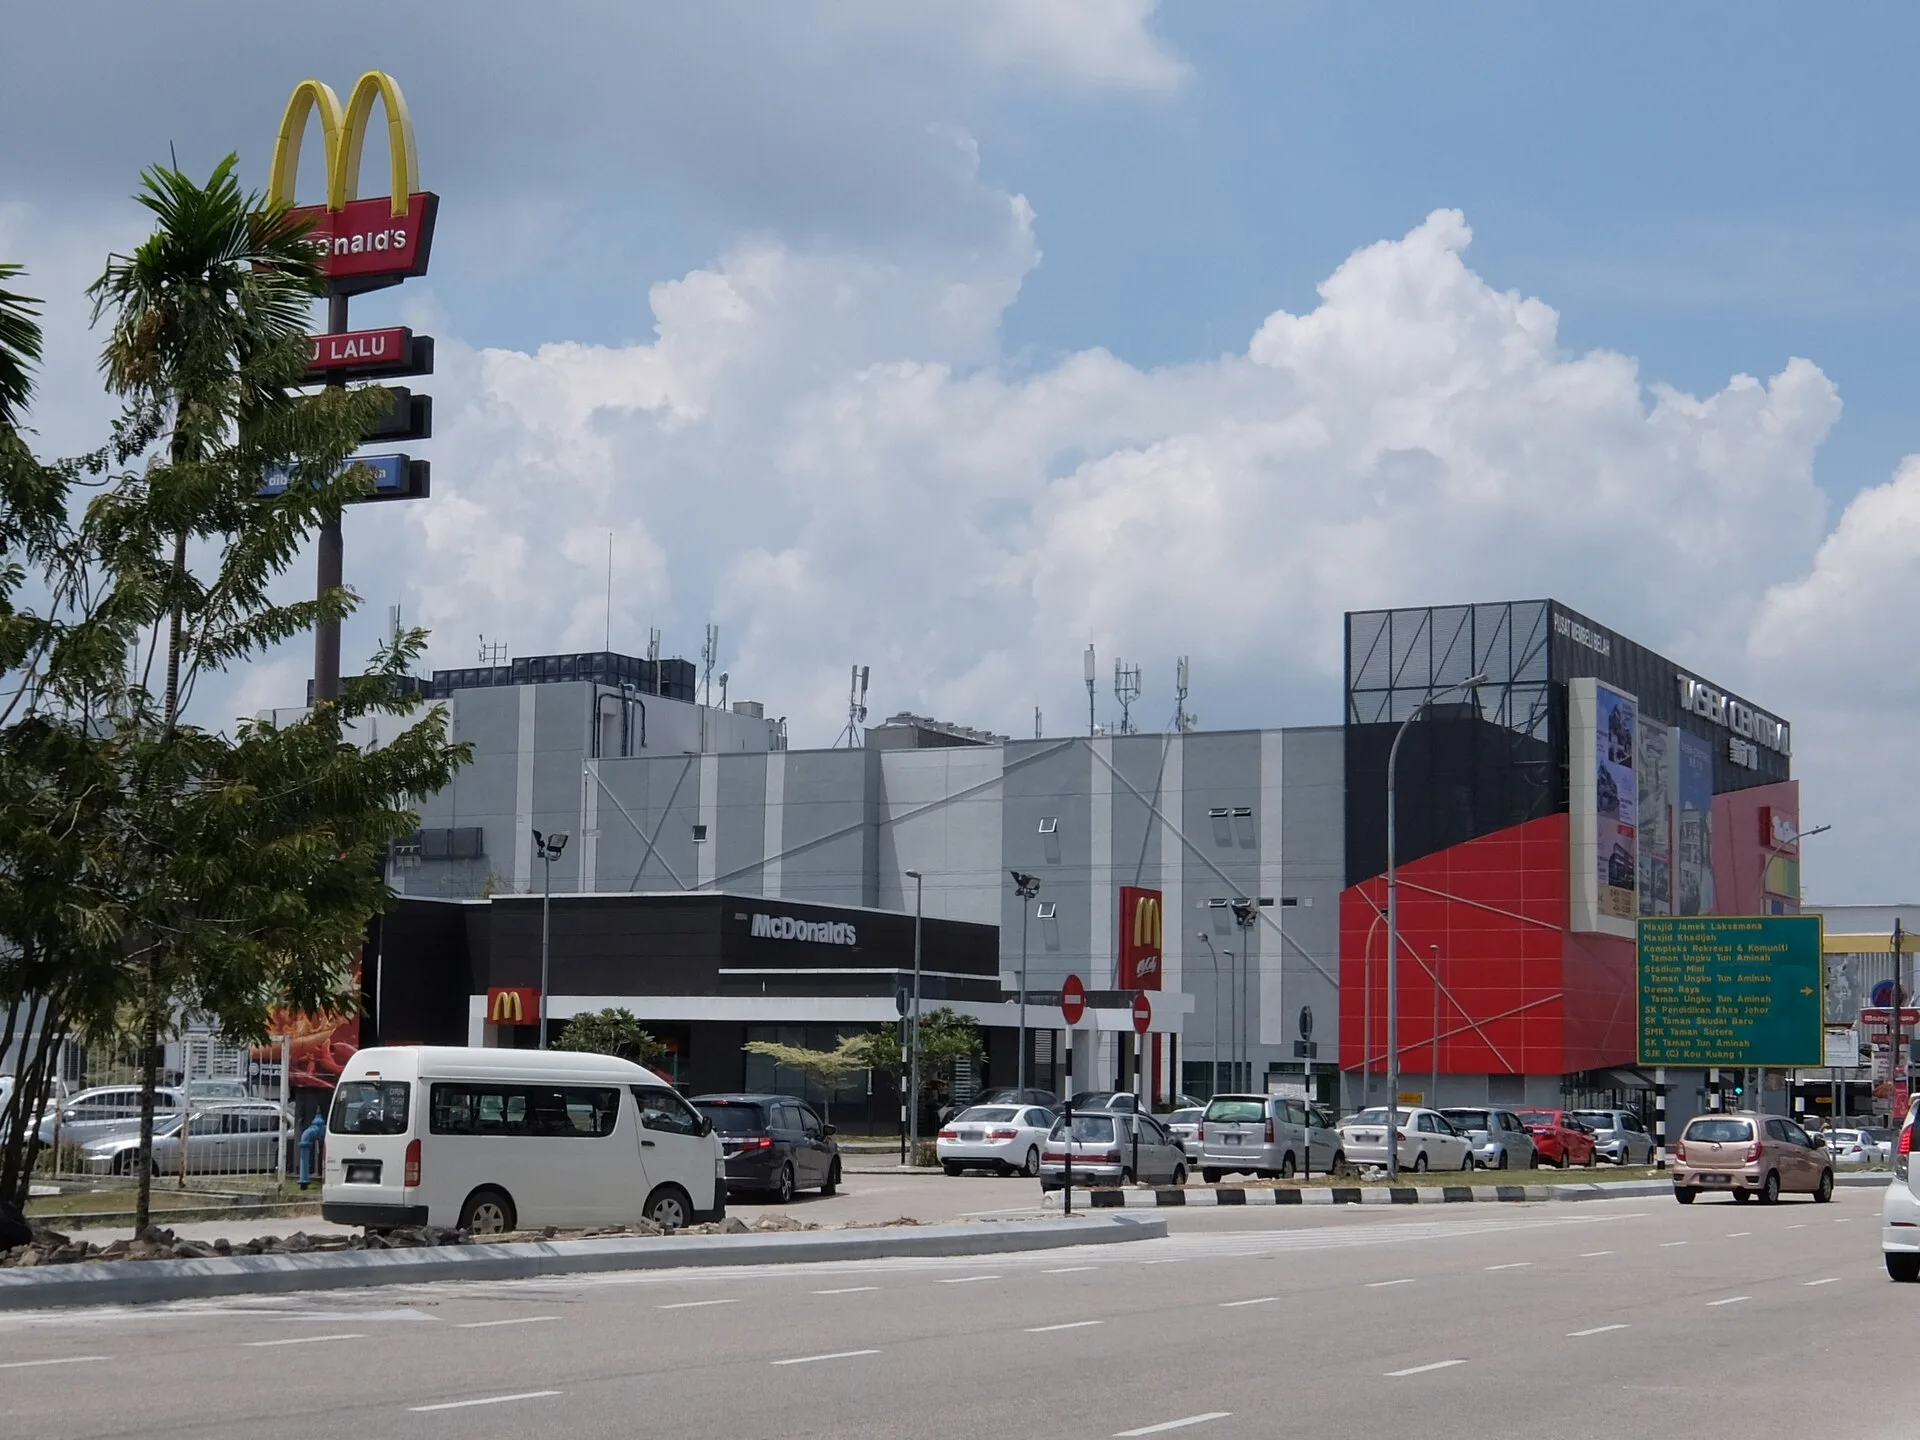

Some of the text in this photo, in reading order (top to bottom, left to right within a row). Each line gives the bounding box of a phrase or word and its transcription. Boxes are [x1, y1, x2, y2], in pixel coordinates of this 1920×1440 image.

[331, 335, 386, 361] LALU
[750, 913, 857, 946] McDonald's
[1644, 922, 1762, 932] Masjid Jamek Laksamana
[1644, 934, 1716, 943] Masjid Khadijah
[1644, 944, 1687, 954] Kompleks
[1693, 944, 1732, 953] Rekreasi
[1748, 943, 1788, 952] Komuniti
[1651, 953, 1770, 963] Taman Ungku Tun Aminah
[1645, 965, 1681, 973] Stadium
[1651, 974, 1771, 984] Taman Ungku Tun Aminah
[1679, 986, 1699, 995] Raya
[1651, 995, 1771, 1005] Taman Ungku Tun Aminah
[1645, 1006, 1656, 1014] SK
[1662, 1006, 1710, 1014] Pendidikan
[1744, 1006, 1768, 1014] Johor
[1645, 1016, 1753, 1025] SK Taman Skudai Baru
[1645, 1028, 1733, 1036] SMK Taman Sutera
[1645, 1039, 1749, 1047] SK Taman Tun Aminah
[1706, 1050, 1734, 1059] Kuang
